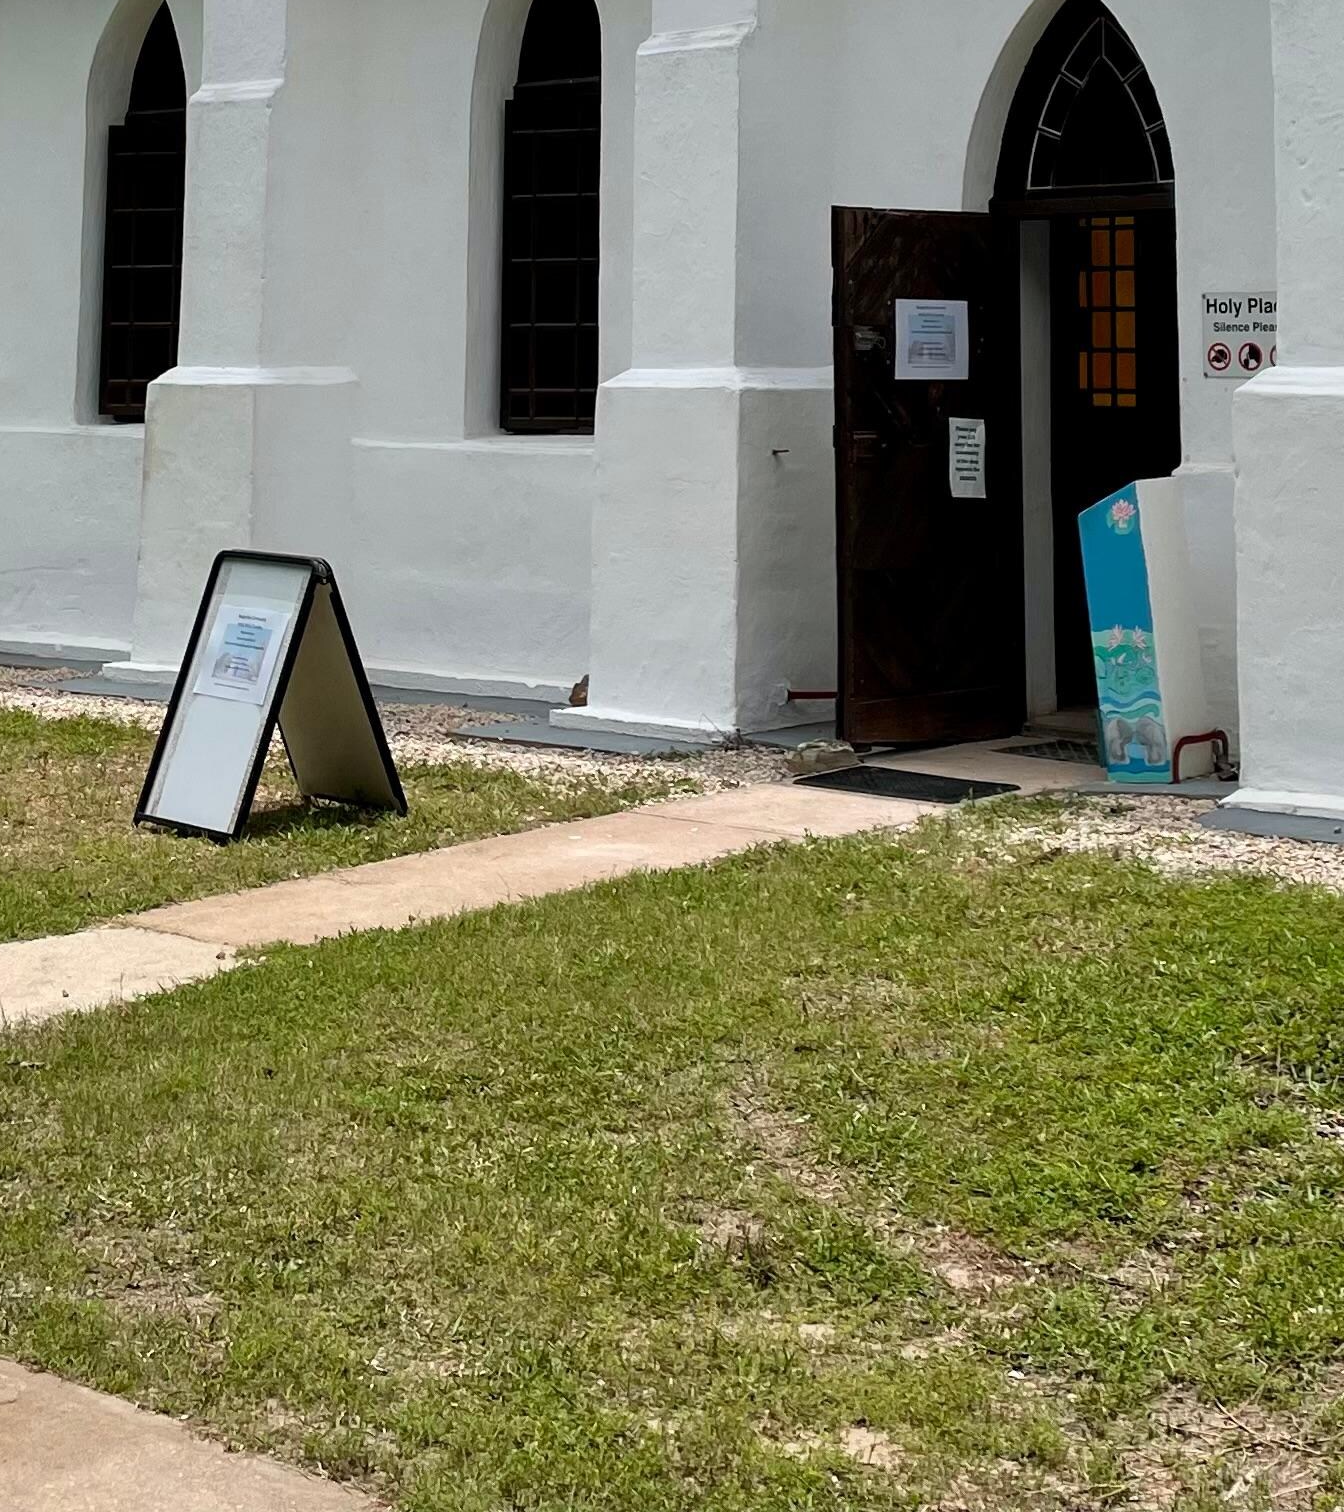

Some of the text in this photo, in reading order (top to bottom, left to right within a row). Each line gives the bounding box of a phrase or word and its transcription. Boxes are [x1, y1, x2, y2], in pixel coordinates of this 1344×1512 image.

[1206, 298, 1242, 318] Holy
[1213, 322, 1277, 332] Silence Plea
